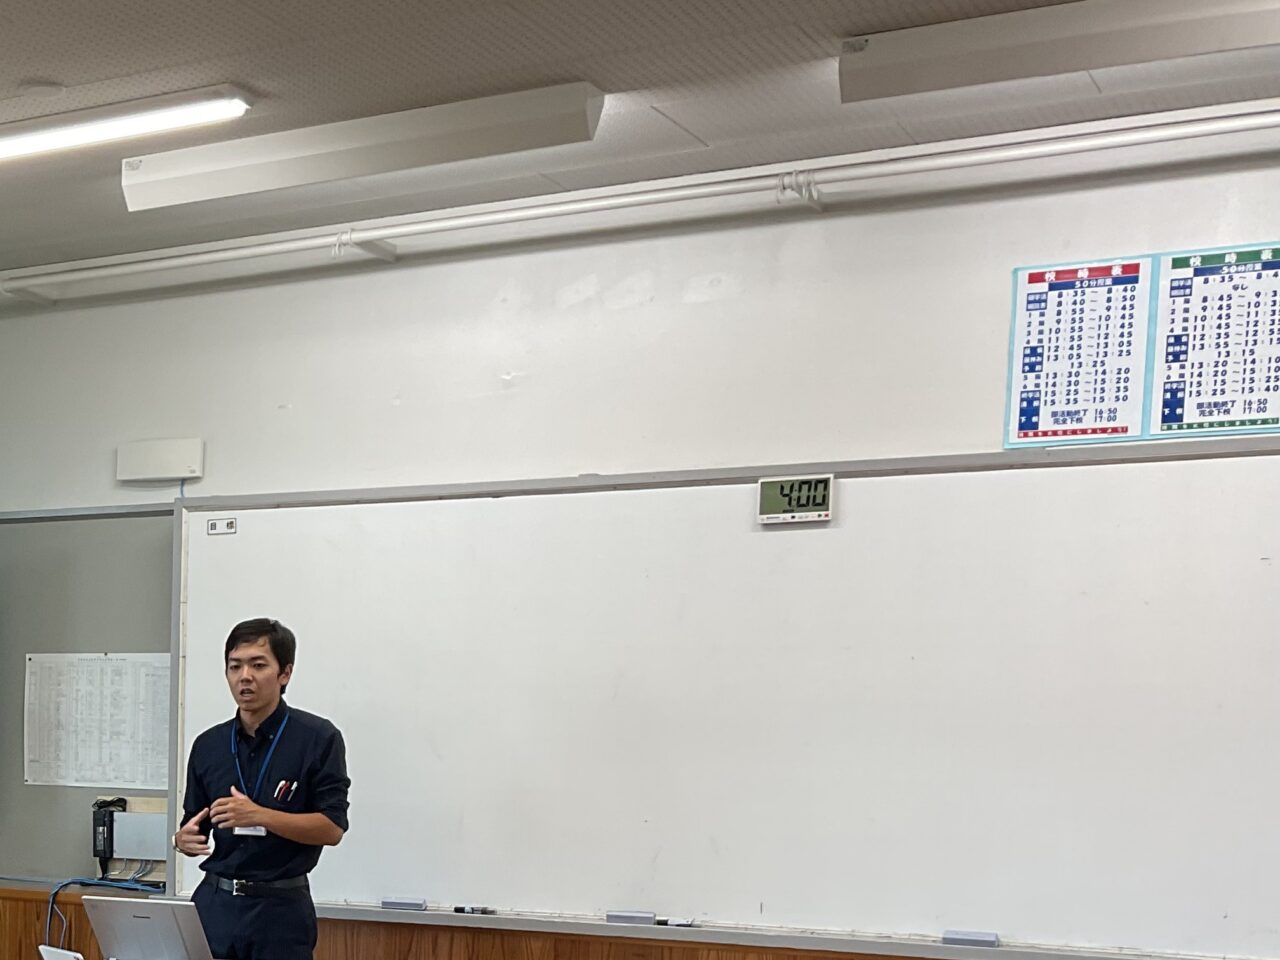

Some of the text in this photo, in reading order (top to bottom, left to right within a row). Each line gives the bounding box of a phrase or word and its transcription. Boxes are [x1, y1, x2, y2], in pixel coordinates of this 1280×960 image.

[1203, 275, 1233, 284] 8:35
[1057, 290, 1086, 298] 8:35
[1107, 286, 1136, 294] 8:40
[1057, 299, 1085, 307] 8:40
[1106, 295, 1135, 303] 8:50
[1202, 294, 1232, 303] 8:45
[1056, 308, 1084, 316] 8:55
[1106, 304, 1134, 312] 9:45
[1201, 304, 1232, 312] 9:45
[1247, 300, 1280, 308] 10:3
[1056, 317, 1084, 325] 9:55
[1099, 313, 1133, 322] 10:45
[1194, 313, 1231, 322] 10:45
[1049, 326, 1083, 335] 10:55
[1098, 322, 1133, 330] 11:45
[1194, 323, 1230, 332] 11:45
[1049, 335, 1082, 343] 11:55
[1098, 331, 1132, 340] 12:45
[1193, 332, 1229, 341] 12:35
[1048, 344, 1082, 352] 12:45
[1097, 341, 1131, 349] 13:05
[1192, 342, 1229, 351] 13:55
[1048, 353, 1081, 361] 13:05
[1096, 350, 1131, 358] 13:25
[1218, 349, 1255, 358] 13:15
[1071, 360, 1105, 368] 13:25
[1191, 361, 1228, 369] 13:20
[1046, 371, 1080, 379] 13:30
[1095, 368, 1129, 376] 14:20
[1190, 370, 1227, 378] 14:20
[1046, 380, 1079, 388] 14:30
[1094, 377, 1129, 385] 15:20
[1190, 379, 1226, 388] 15:15
[1242, 376, 1279, 384] 15:25
[1045, 389, 1078, 397] 15:25
[1094, 386, 1128, 394] 15:35
[1189, 388, 1225, 397] 15:25
[1242, 385, 1279, 394] 15:40
[1044, 398, 1078, 406] 15:35
[1093, 395, 1128, 403] 15:50
[1243, 398, 1268, 406] 16:50
[1095, 408, 1117, 416] 16:50
[780, 480, 827, 507] 4:00
